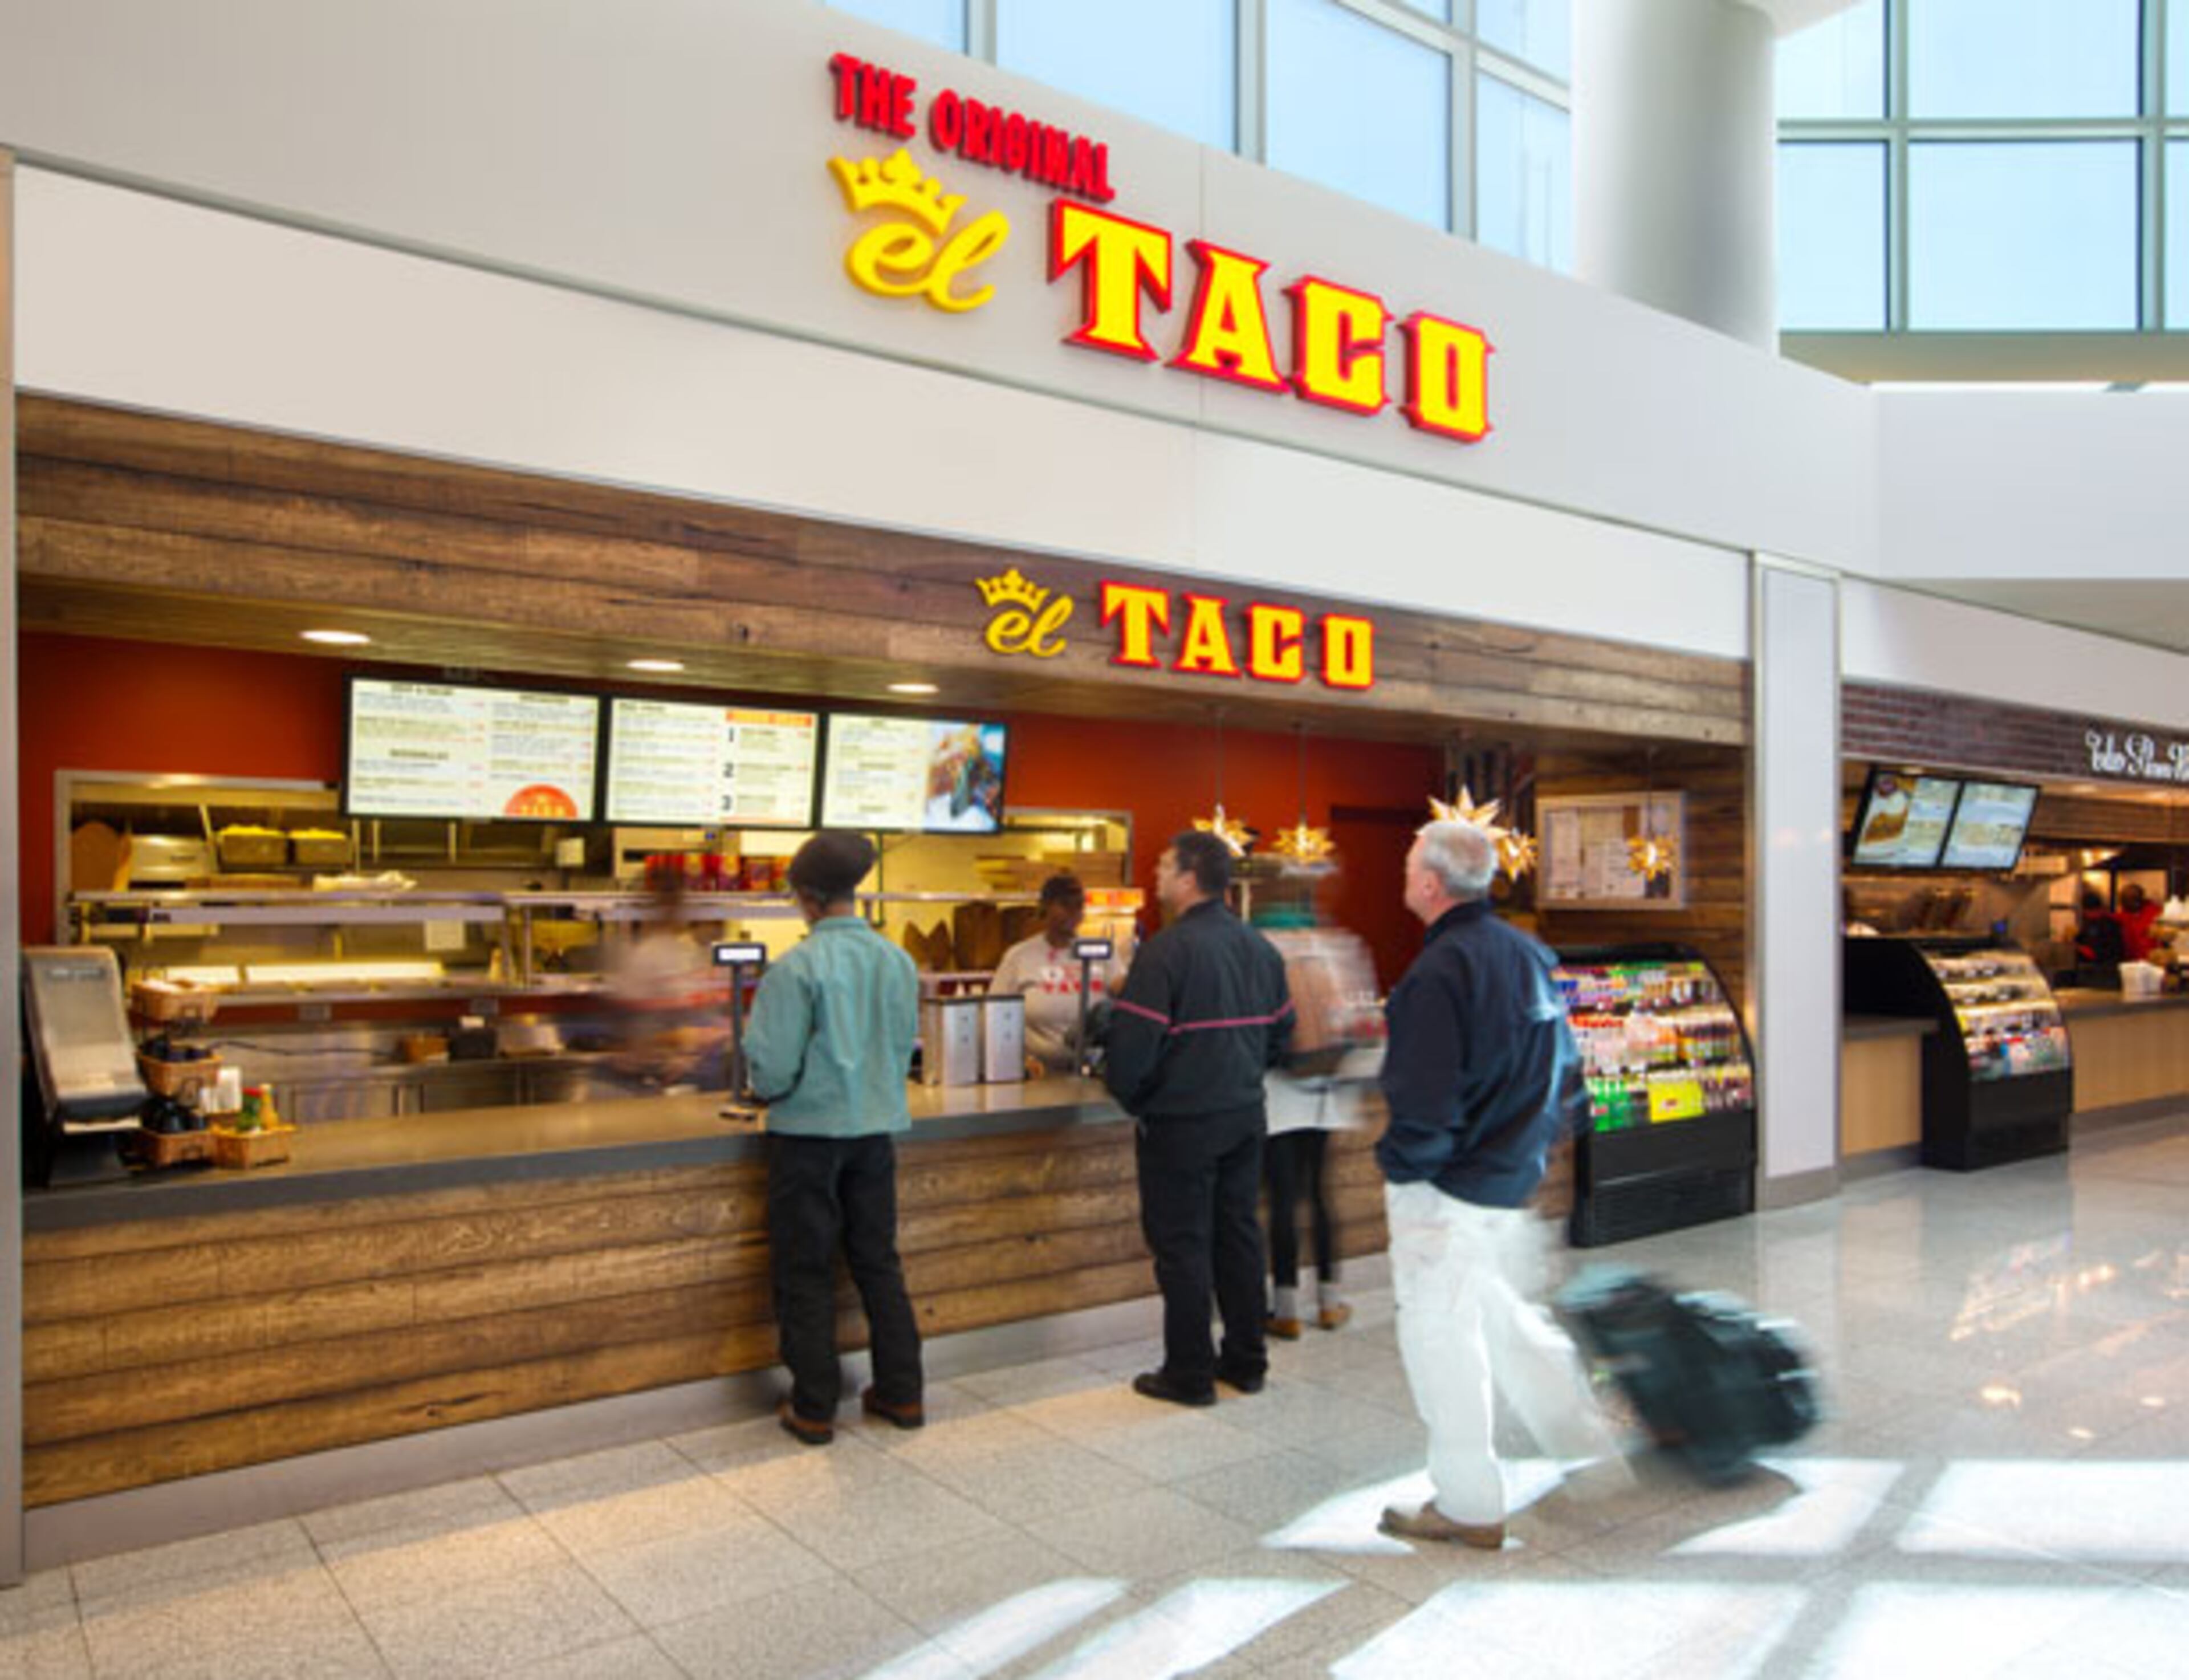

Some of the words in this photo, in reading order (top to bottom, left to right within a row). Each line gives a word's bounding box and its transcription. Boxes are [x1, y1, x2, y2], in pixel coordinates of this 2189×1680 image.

[829, 52, 917, 141] THE
[928, 89, 1116, 203] ORIGINAL
[845, 209, 1011, 314] el
[1047, 196, 1494, 444] TACO
[985, 595, 1074, 658] el
[1100, 578, 1375, 690] TACO
